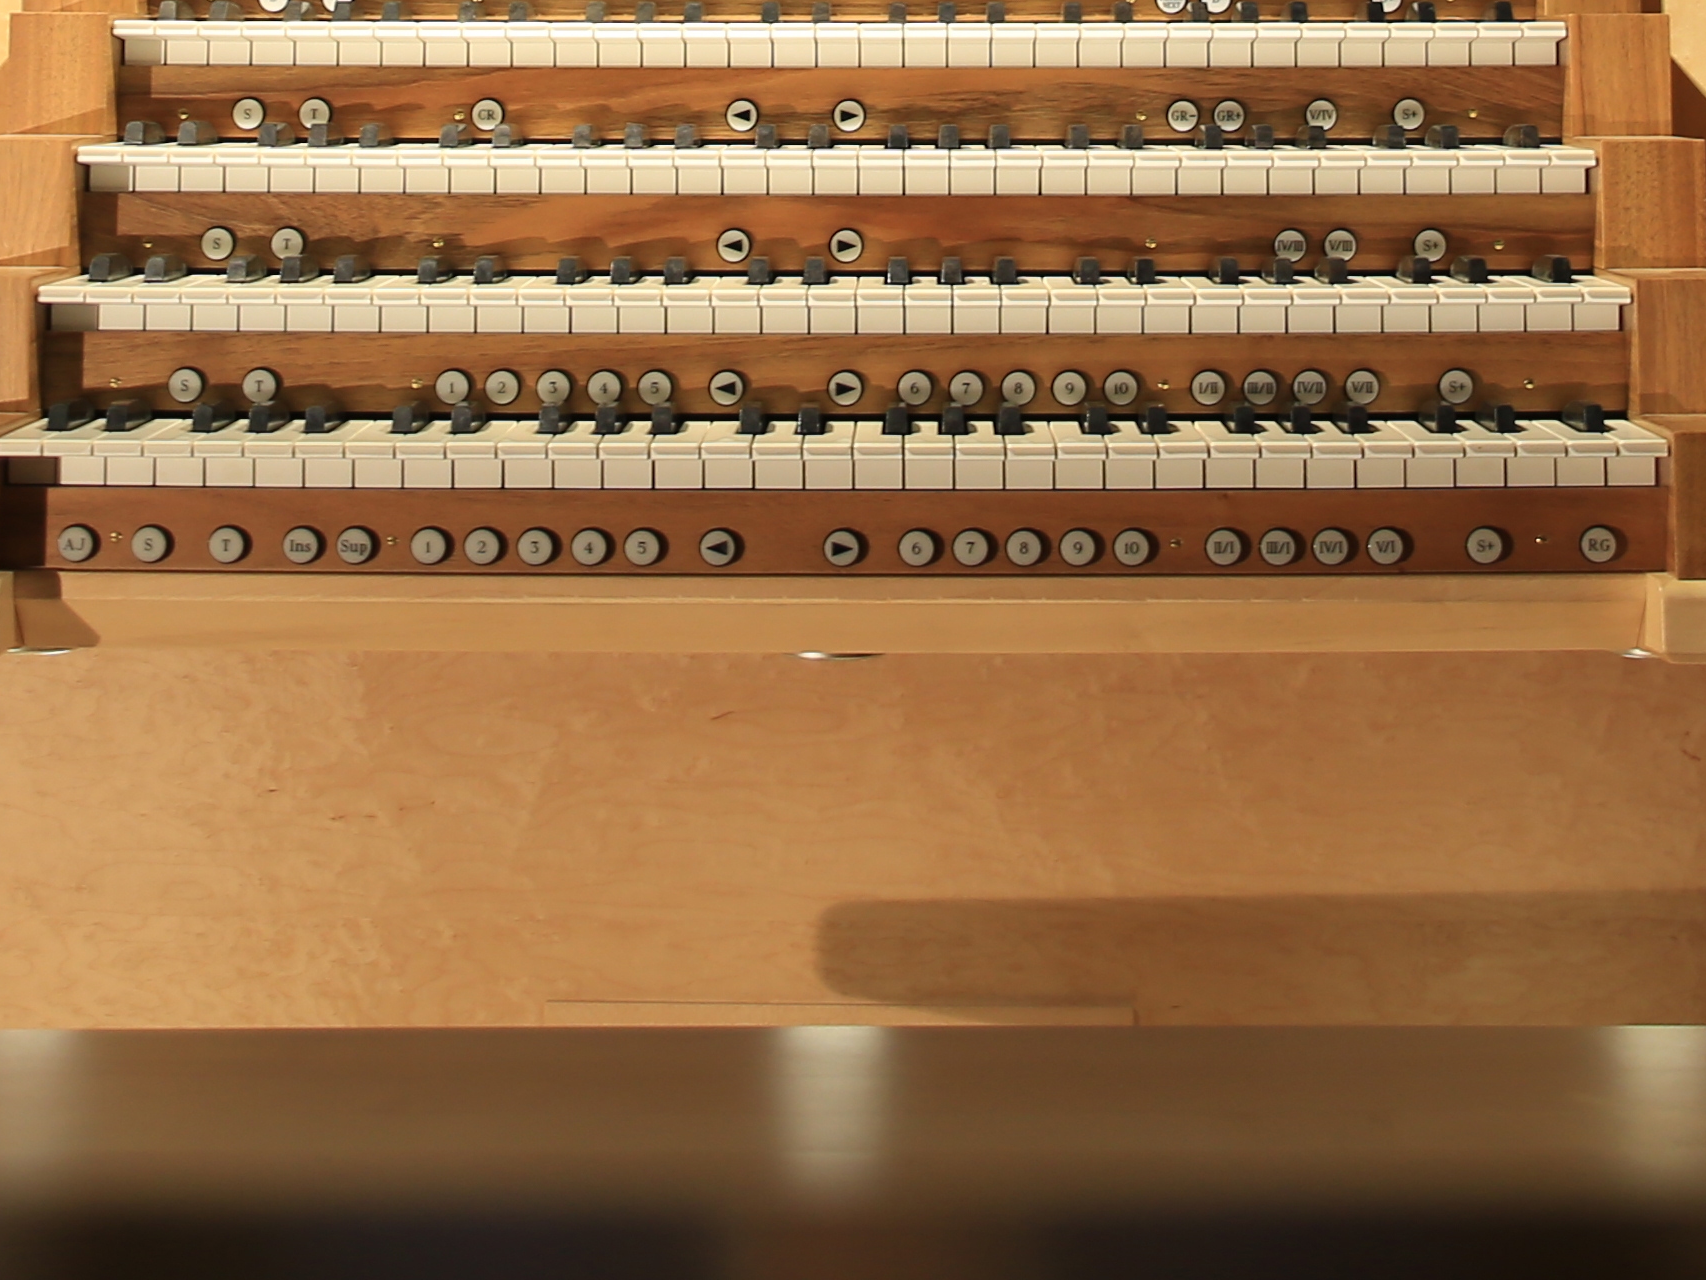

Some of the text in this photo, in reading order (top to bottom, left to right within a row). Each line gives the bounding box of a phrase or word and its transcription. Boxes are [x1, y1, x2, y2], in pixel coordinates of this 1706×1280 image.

[243, 108, 252, 120] S
[310, 108, 319, 120] T
[477, 109, 496, 121] CR
[1216, 109, 1242, 122] GR+
[1402, 108, 1418, 120] S+
[212, 237, 221, 250] S
[282, 237, 292, 251] T
[1422, 239, 1439, 252] S+
[179, 379, 190, 393] S
[253, 380, 264, 393] T
[448, 380, 455, 395] 1
[496, 381, 507, 395] 2
[548, 380, 559, 395] 3
[598, 380, 609, 395] 4
[649, 381, 660, 395] 5
[909, 382, 921, 396] 6
[961, 382, 971, 397] 7
[1013, 382, 1024, 395] 8
[1064, 382, 1075, 395] 9
[1113, 382, 1130, 396] 10
[1448, 380, 1467, 395] S+
[62, 537, 87, 552] AJ
[144, 537, 153, 552] S
[221, 538, 231, 552] T
[289, 539, 313, 553] Ins
[340, 540, 368, 557] Sup
[424, 540, 432, 555] 1
[476, 540, 487, 554] 2
[530, 540, 540, 554] 3
[583, 541, 594, 555] 4
[637, 541, 647, 555] 5
[911, 542, 922, 556] 6
[965, 541, 976, 554] 7
[1019, 541, 1029, 555] 8
[1073, 541, 1084, 555] 9
[1124, 541, 1140, 555] 10
[1476, 539, 1496, 553] S+
[1588, 538, 1611, 552] RG
